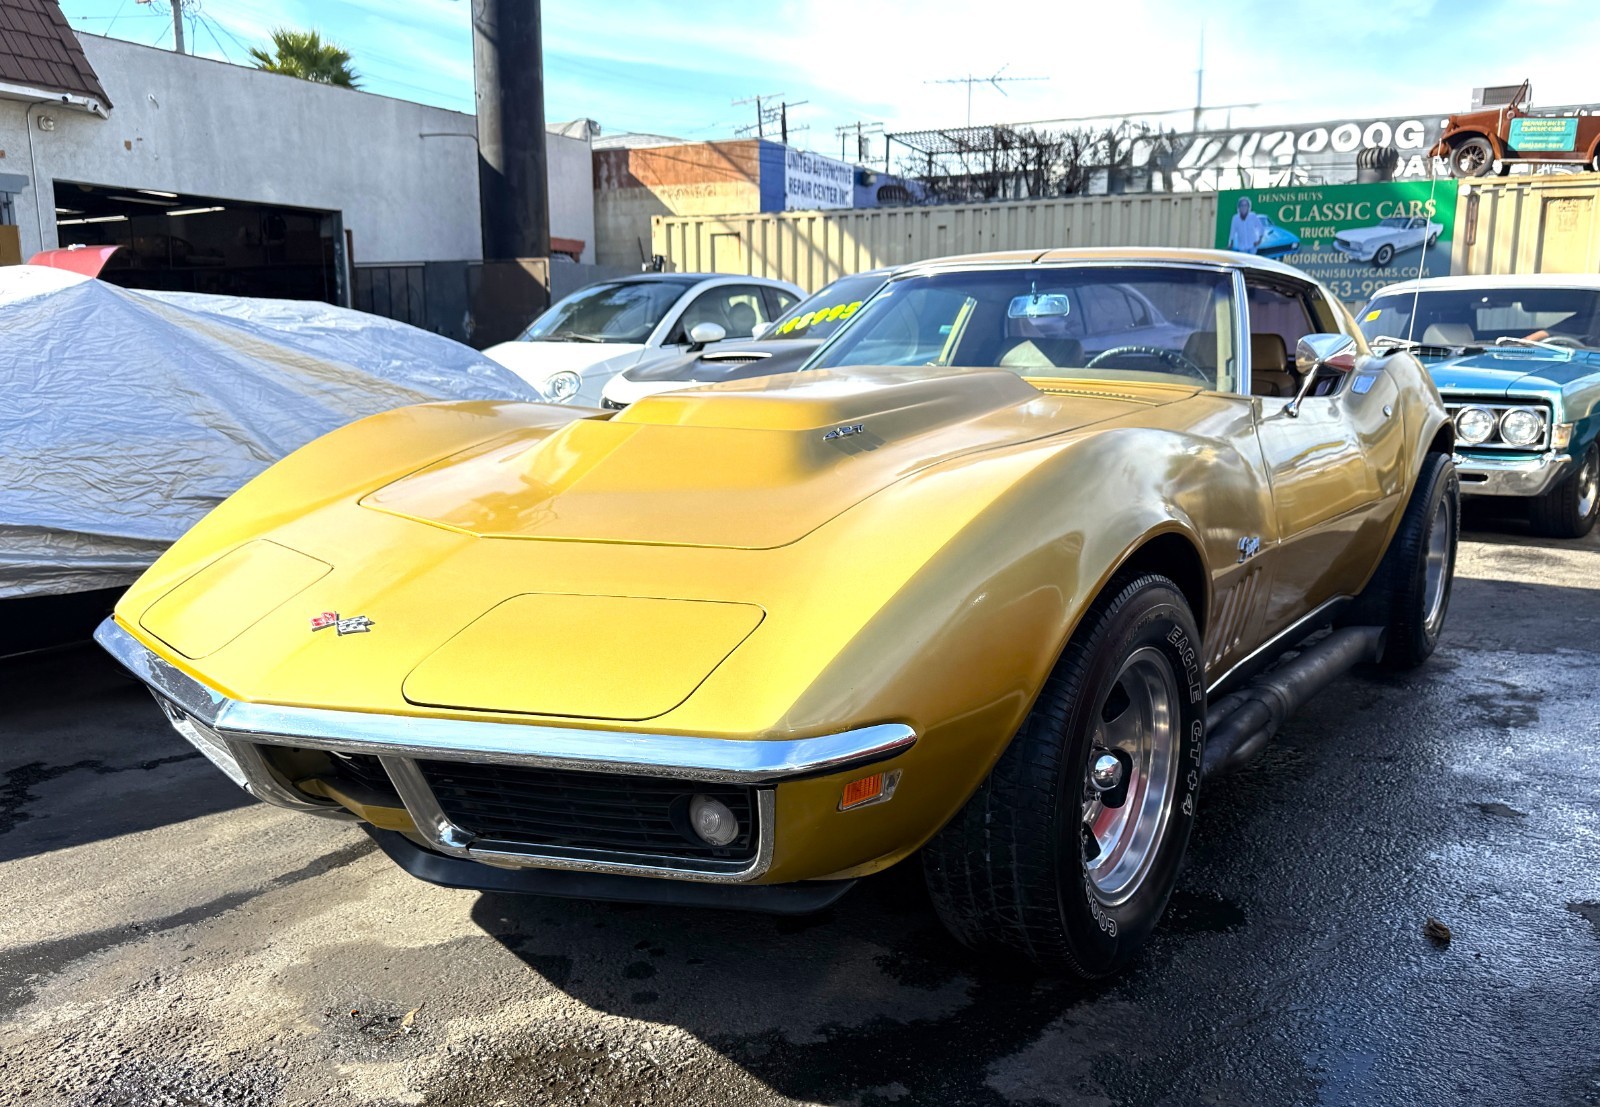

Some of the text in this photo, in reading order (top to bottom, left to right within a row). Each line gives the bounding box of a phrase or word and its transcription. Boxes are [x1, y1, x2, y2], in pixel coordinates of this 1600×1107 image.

[788, 152, 852, 185] UNITED AUTOMOTIVE
[788, 177, 812, 199] REPAIR
[813, 182, 838, 204] CENTER
[1258, 191, 1324, 204] DENNIS BUYS
[1278, 199, 1437, 223] CLASSIC CARS
[1300, 226, 1336, 239] TRUCKS
[1312, 240, 1321, 251] &
[1282, 252, 1351, 265] MOTORCYCLES
[1305, 266, 1430, 279] NNISBUYSCARS.COM
[1166, 623, 1202, 704] EAGLE
